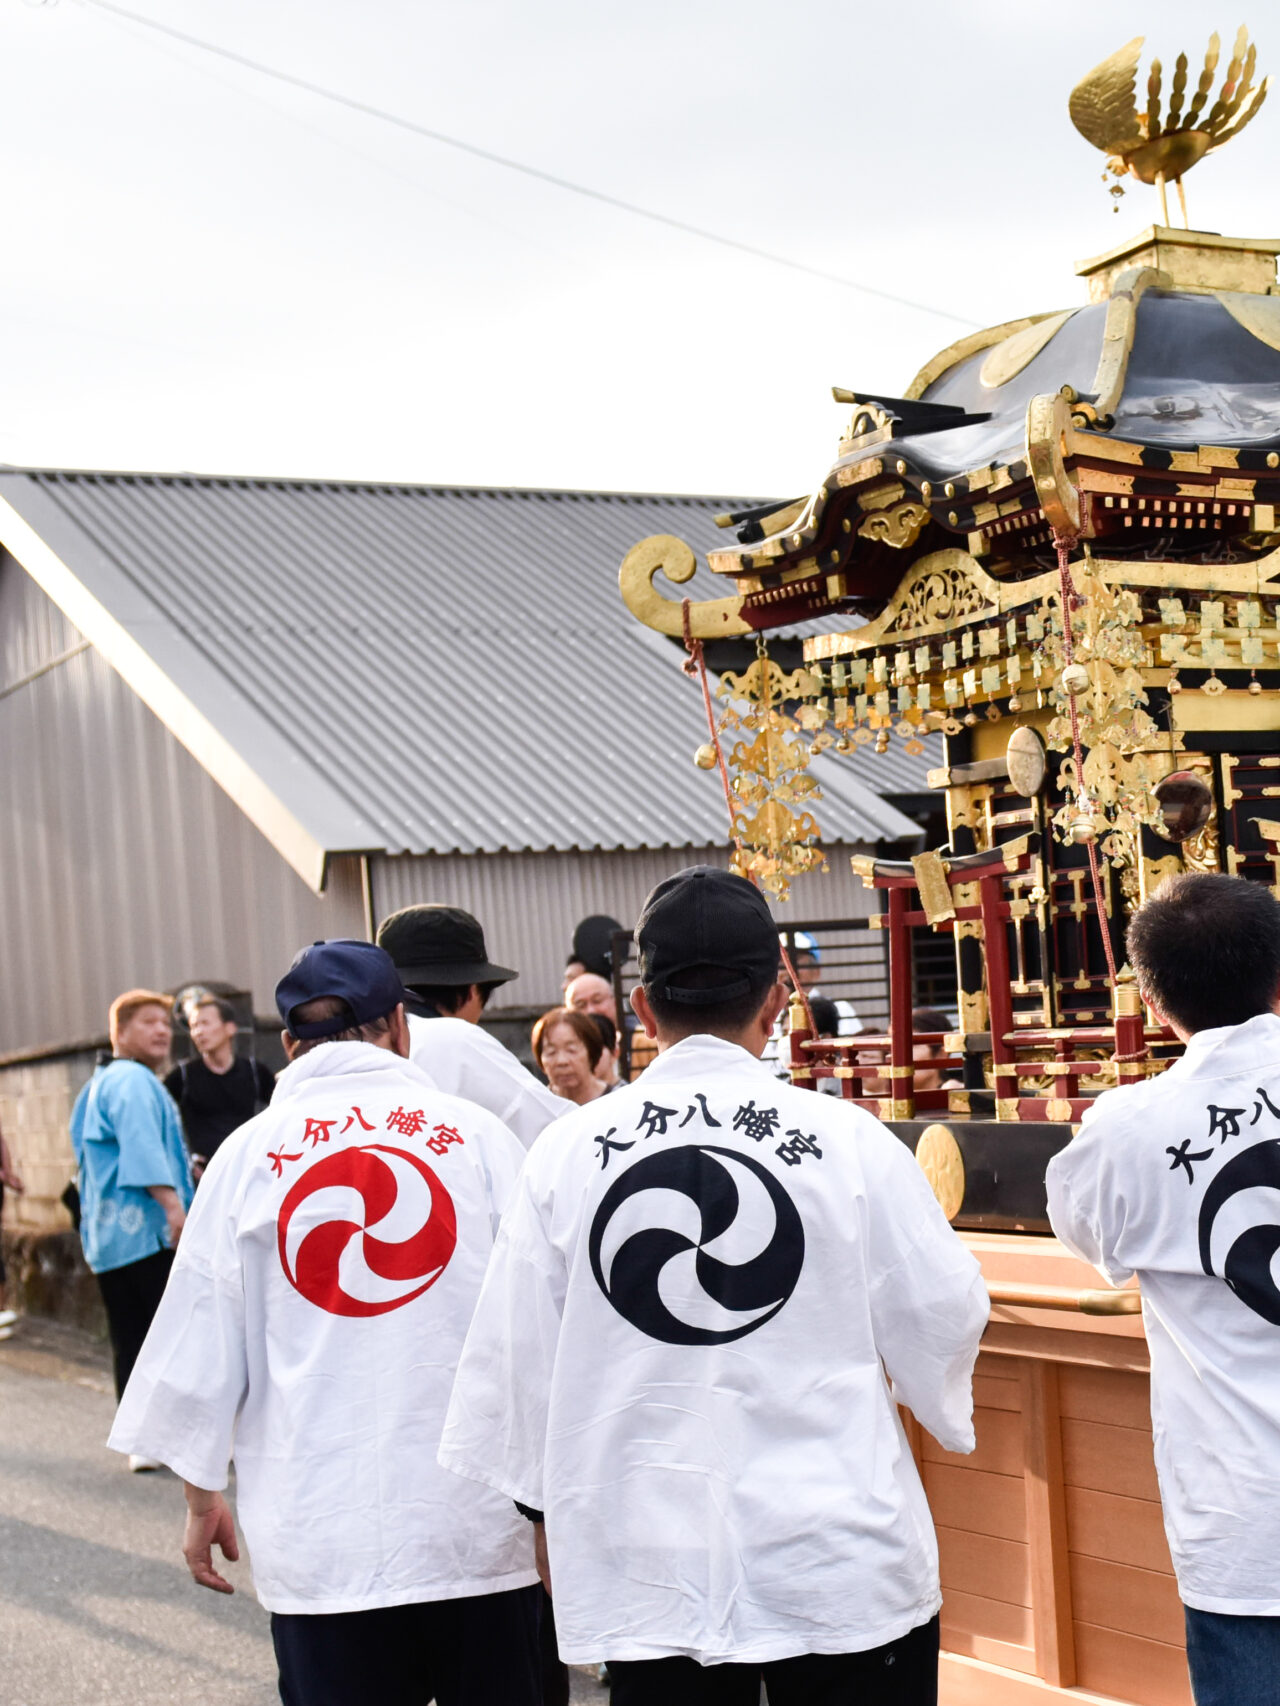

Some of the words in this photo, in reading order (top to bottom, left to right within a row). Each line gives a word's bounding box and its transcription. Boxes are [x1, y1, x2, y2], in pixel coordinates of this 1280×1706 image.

[266, 1106, 465, 1178] 大分八幡宮
[594, 1093, 823, 1171] 大分八幡宮
